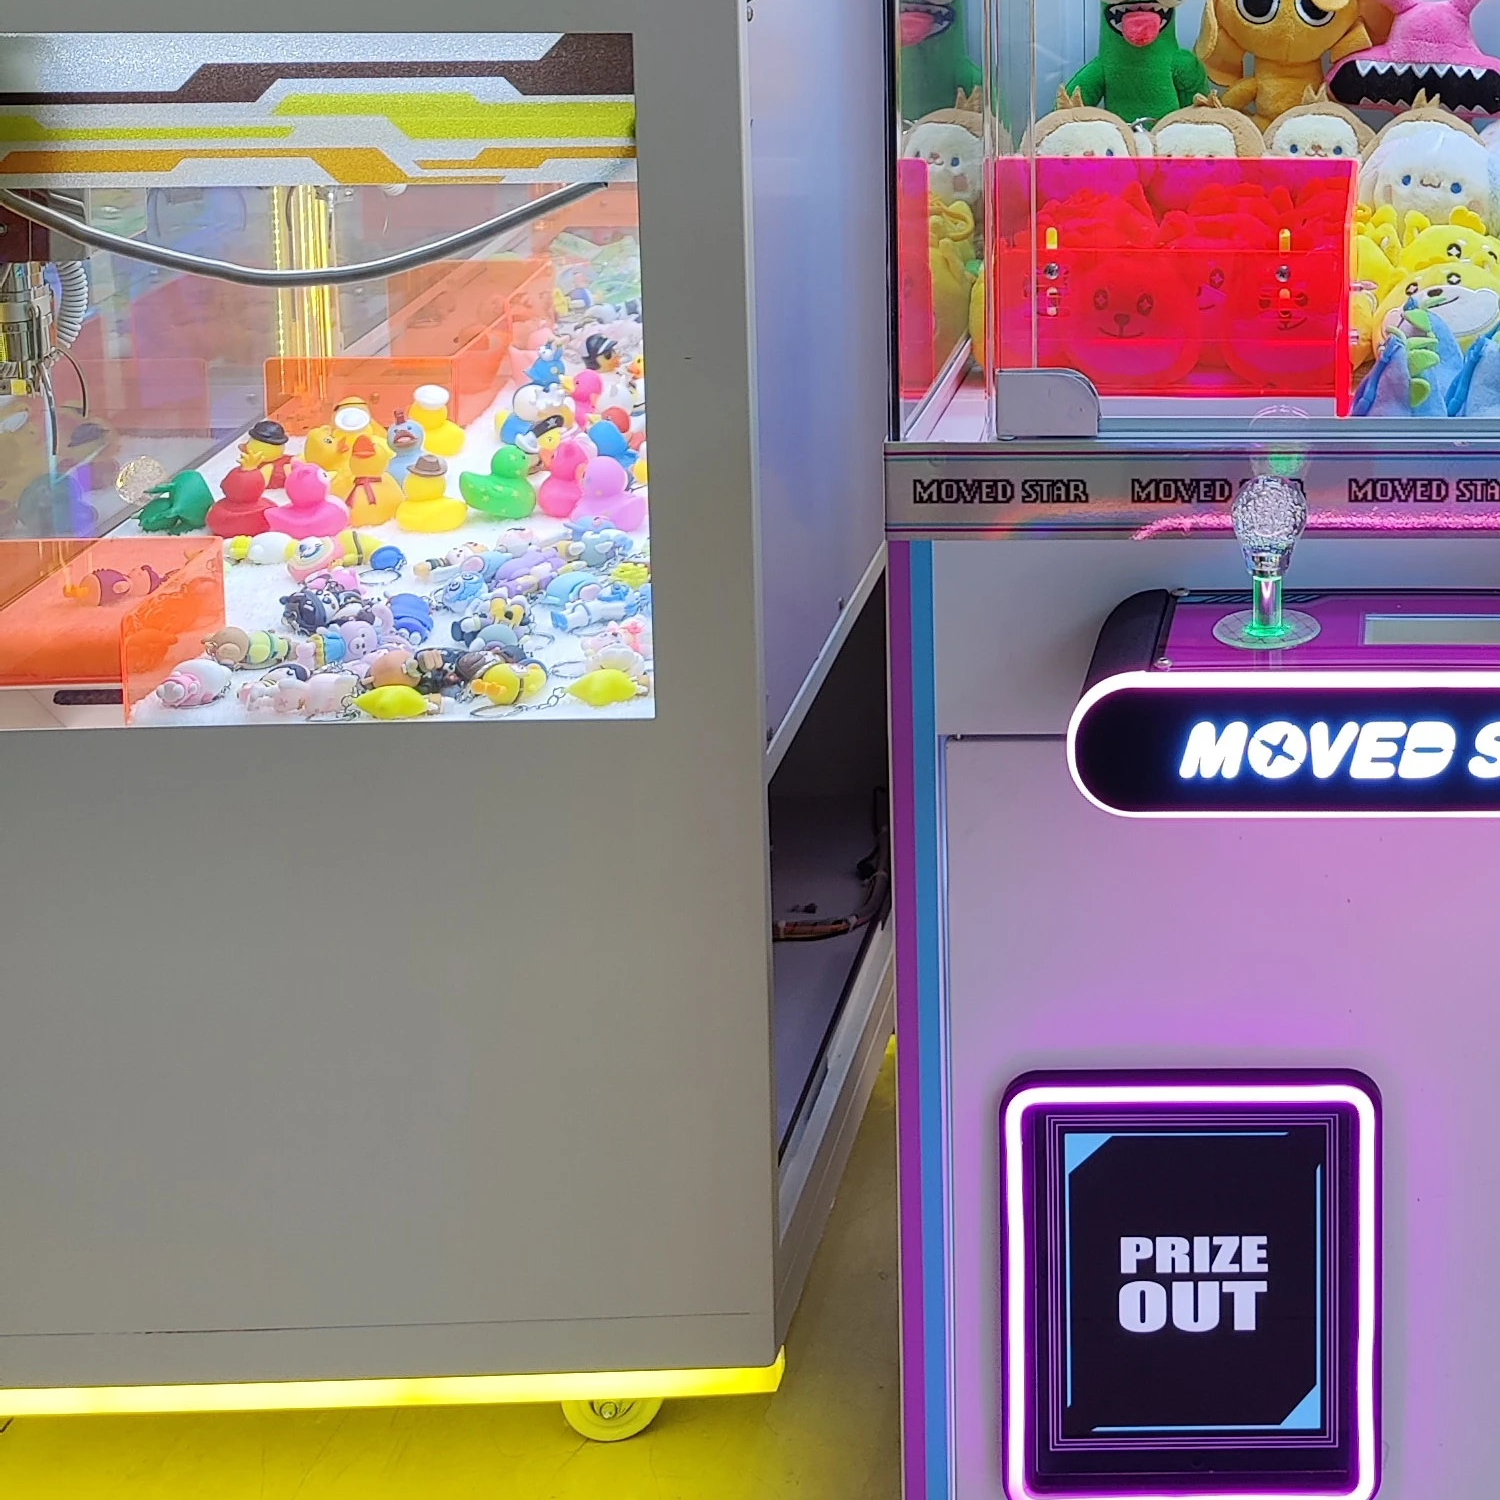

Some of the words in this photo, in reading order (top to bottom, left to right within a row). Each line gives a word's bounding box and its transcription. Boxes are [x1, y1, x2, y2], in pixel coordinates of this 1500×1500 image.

[914, 479, 1013, 504] MOVED
[1021, 480, 1088, 504] STAR
[1131, 478, 1231, 503] MOVED
[1349, 479, 1449, 503] MOVED
[1179, 719, 1457, 780] MOVED
[1120, 1236, 1269, 1274] PRIZE
[1118, 1280, 1268, 1333] OUT
